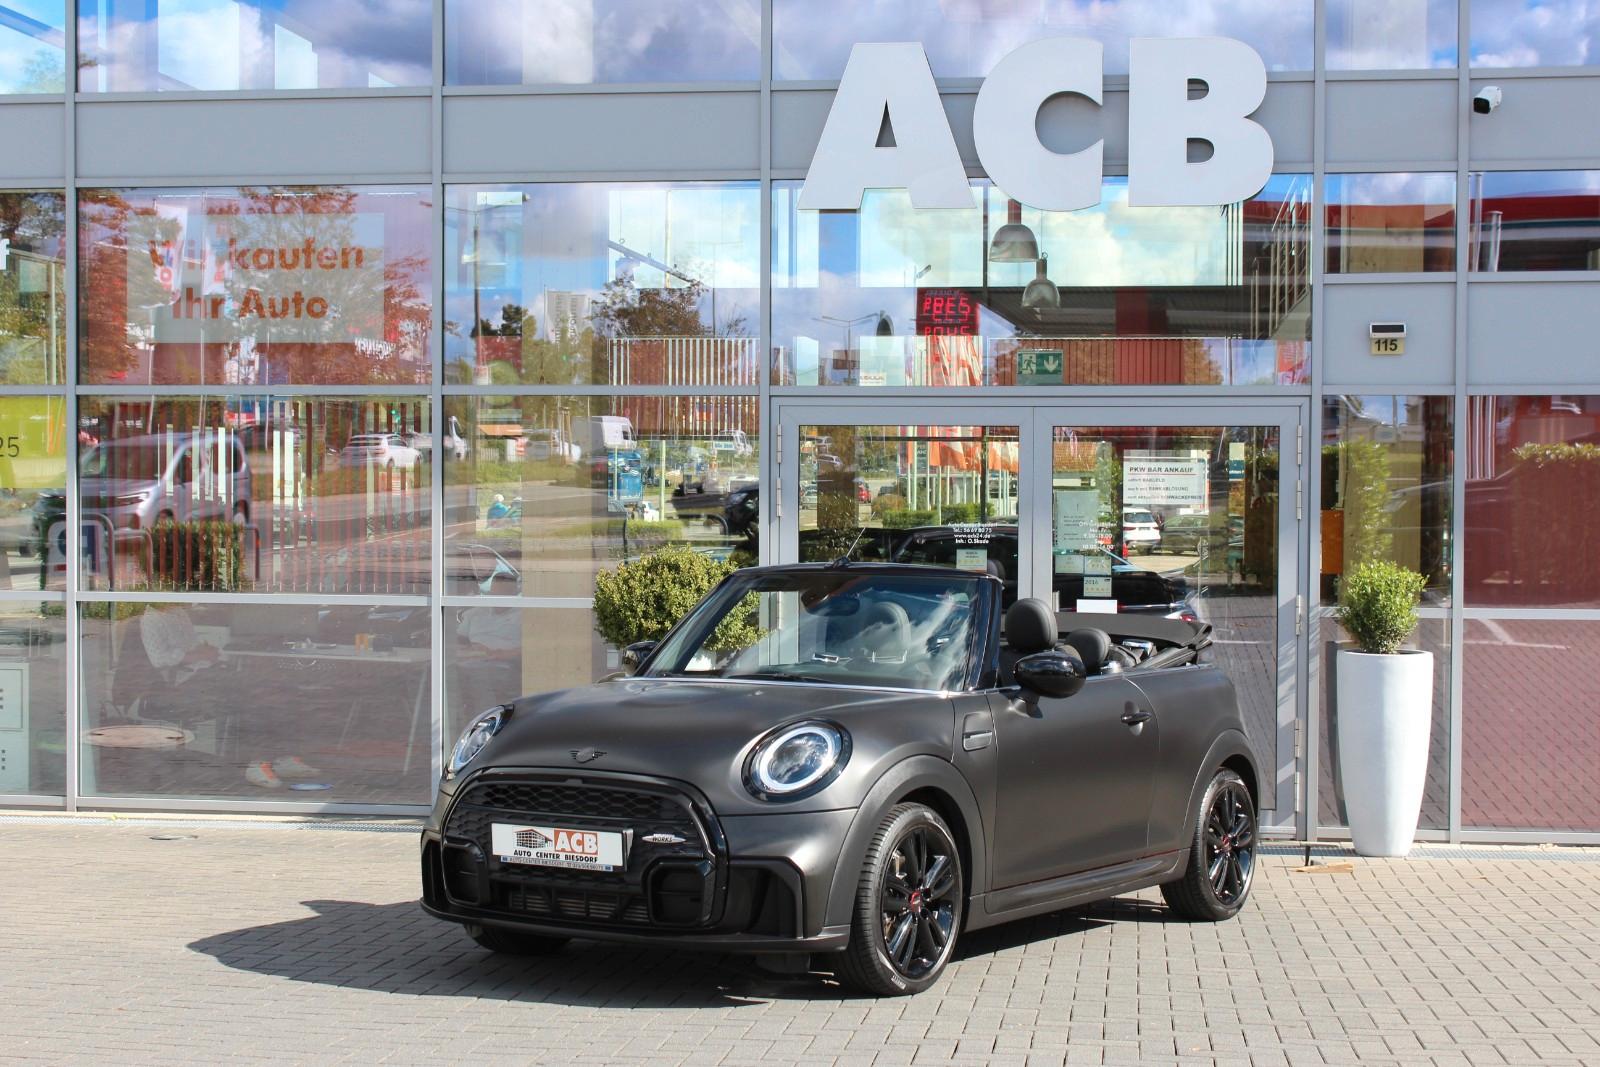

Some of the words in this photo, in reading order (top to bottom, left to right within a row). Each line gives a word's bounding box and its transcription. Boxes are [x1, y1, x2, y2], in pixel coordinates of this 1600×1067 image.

[797, 38, 1274, 211] ACB
[229, 237, 365, 270] kaufen
[172, 287, 226, 320] Ihr
[1374, 338, 1398, 352] 115
[554, 831, 598, 853] ACB
[513, 849, 532, 857] AUTO
[535, 850, 561, 860] CENTER
[564, 854, 599, 863] BIESDORF
